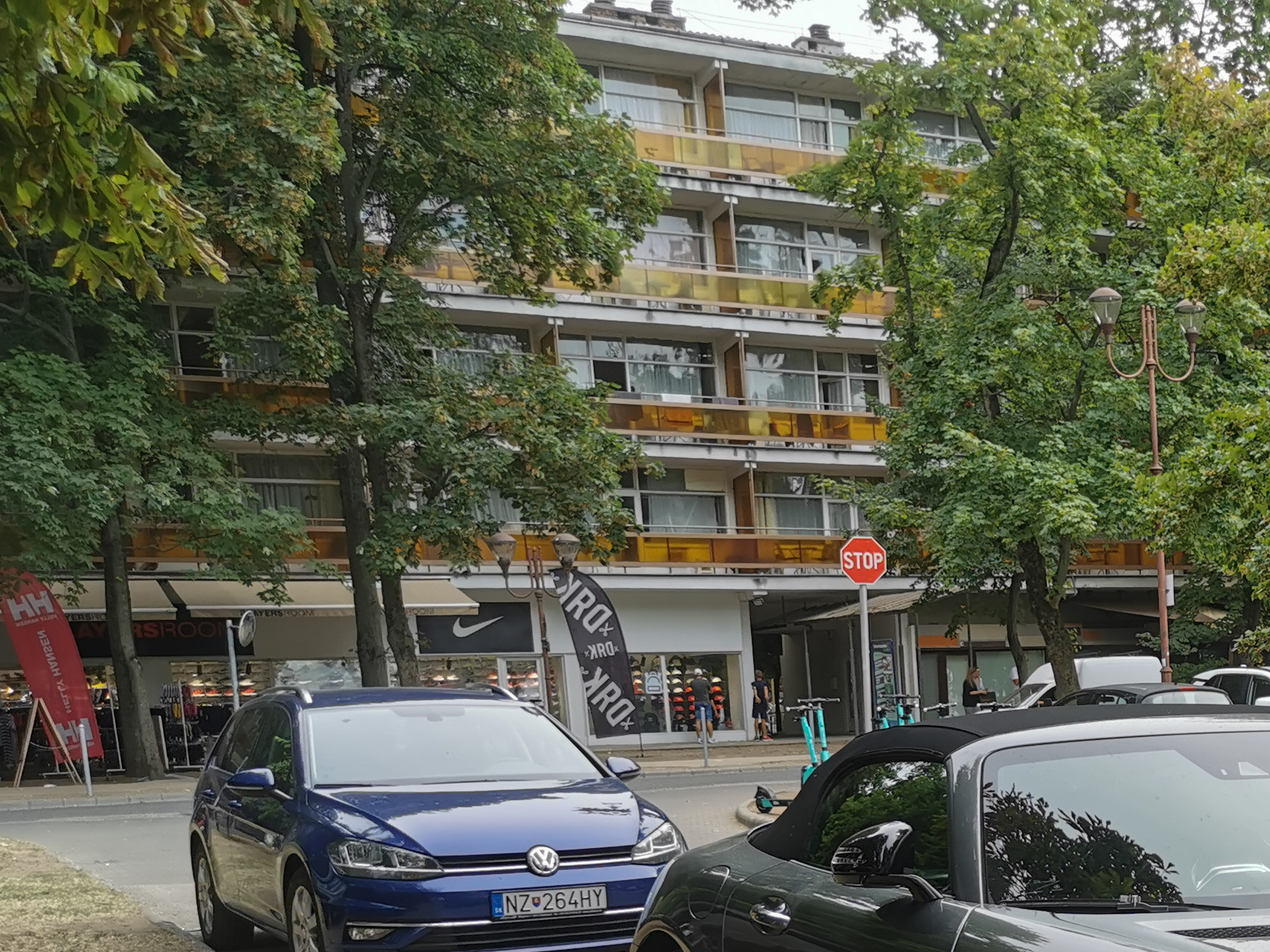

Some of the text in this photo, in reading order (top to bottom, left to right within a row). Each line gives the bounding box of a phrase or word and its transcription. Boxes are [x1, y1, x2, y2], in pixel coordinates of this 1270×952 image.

[843, 551, 884, 570] STOP
[529, 847, 558, 876] VW
[505, 888, 603, 914] NZ 264HY
